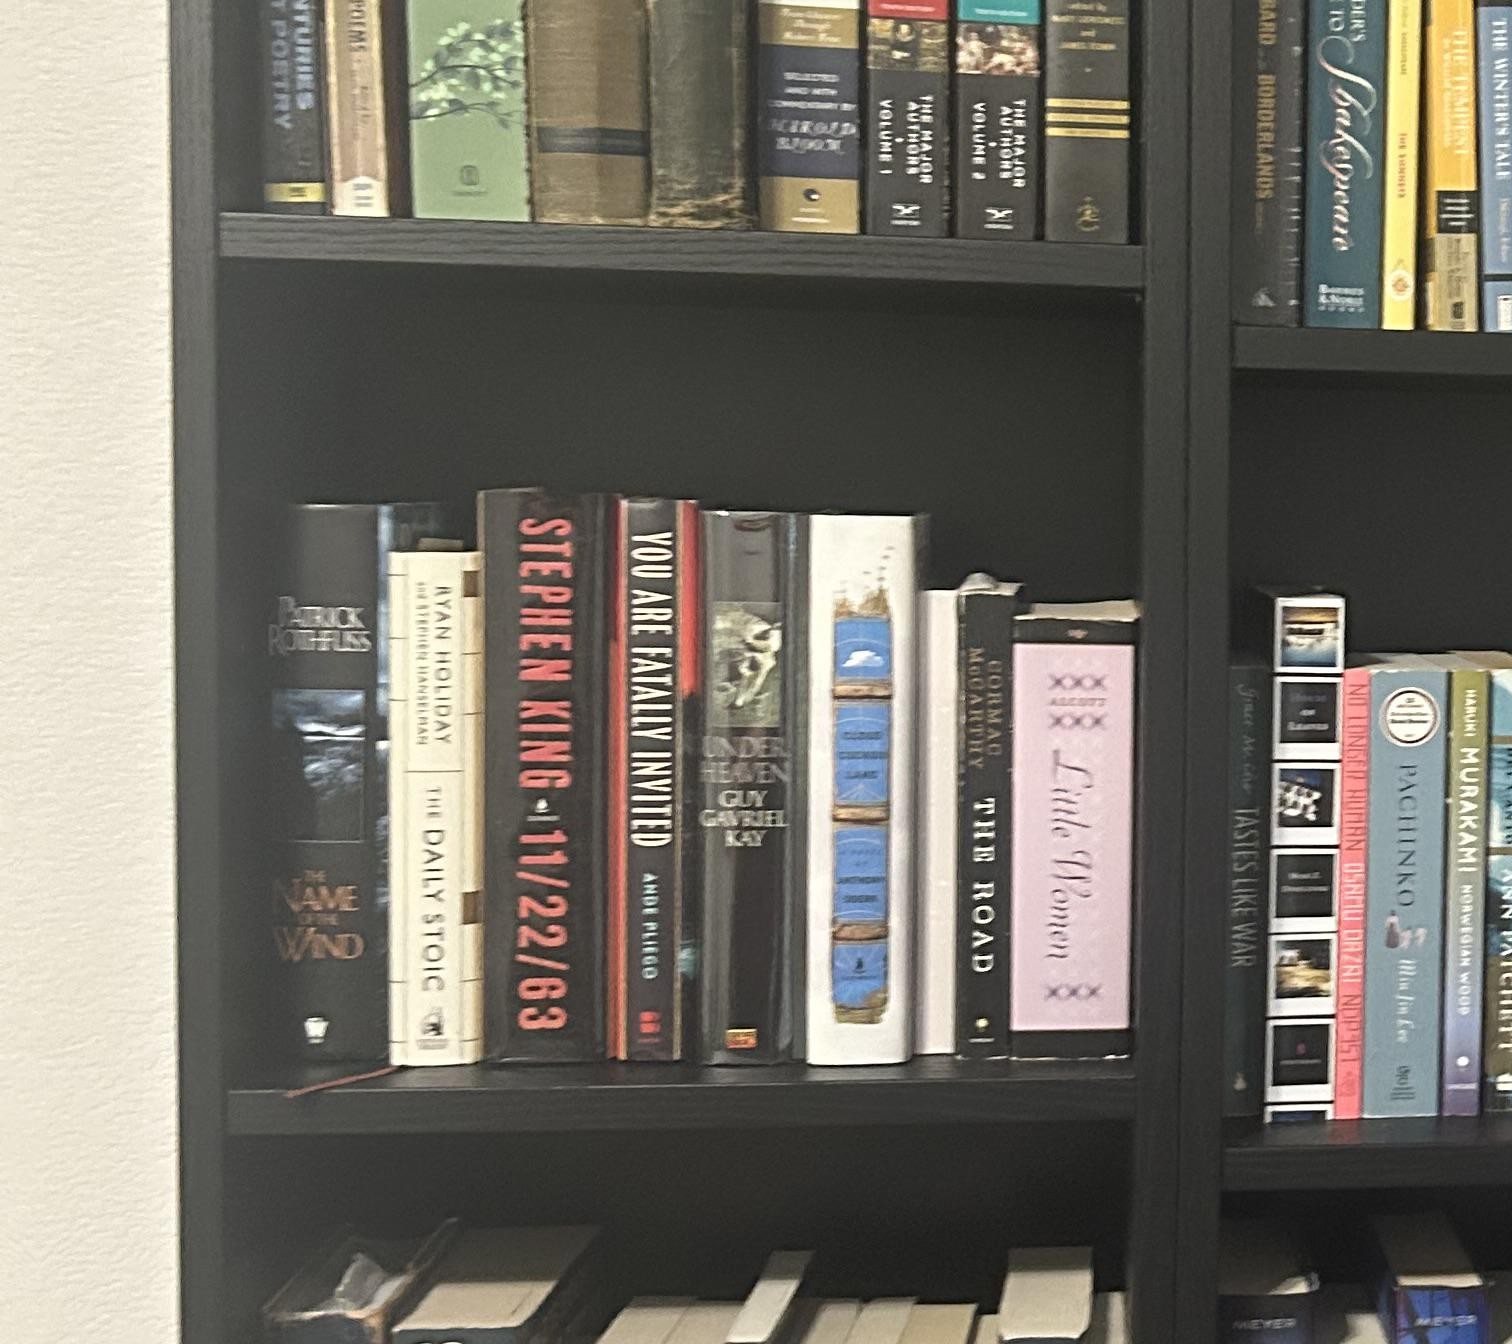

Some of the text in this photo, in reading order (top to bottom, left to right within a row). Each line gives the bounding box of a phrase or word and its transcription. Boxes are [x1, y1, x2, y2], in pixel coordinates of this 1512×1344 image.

[1328, 8, 1344, 31] TO
[1493, 18, 1509, 179] THE WINTER'S TALE
[1317, 37, 1377, 251] Shakespeare
[434, 586, 451, 744] RYAN HOLIDAY
[518, 518, 572, 790] STEPHEN KING
[631, 531, 672, 847] YOU ARE FATALLY INVITED
[1397, 764, 1417, 908] PACHINKO
[1458, 690, 1478, 872] HARUKI MURAKAMI
[423, 787, 444, 992] THE DAILY STOIC
[515, 830, 570, 1030] 11/22/63
[972, 798, 996, 973] THE ROAD
